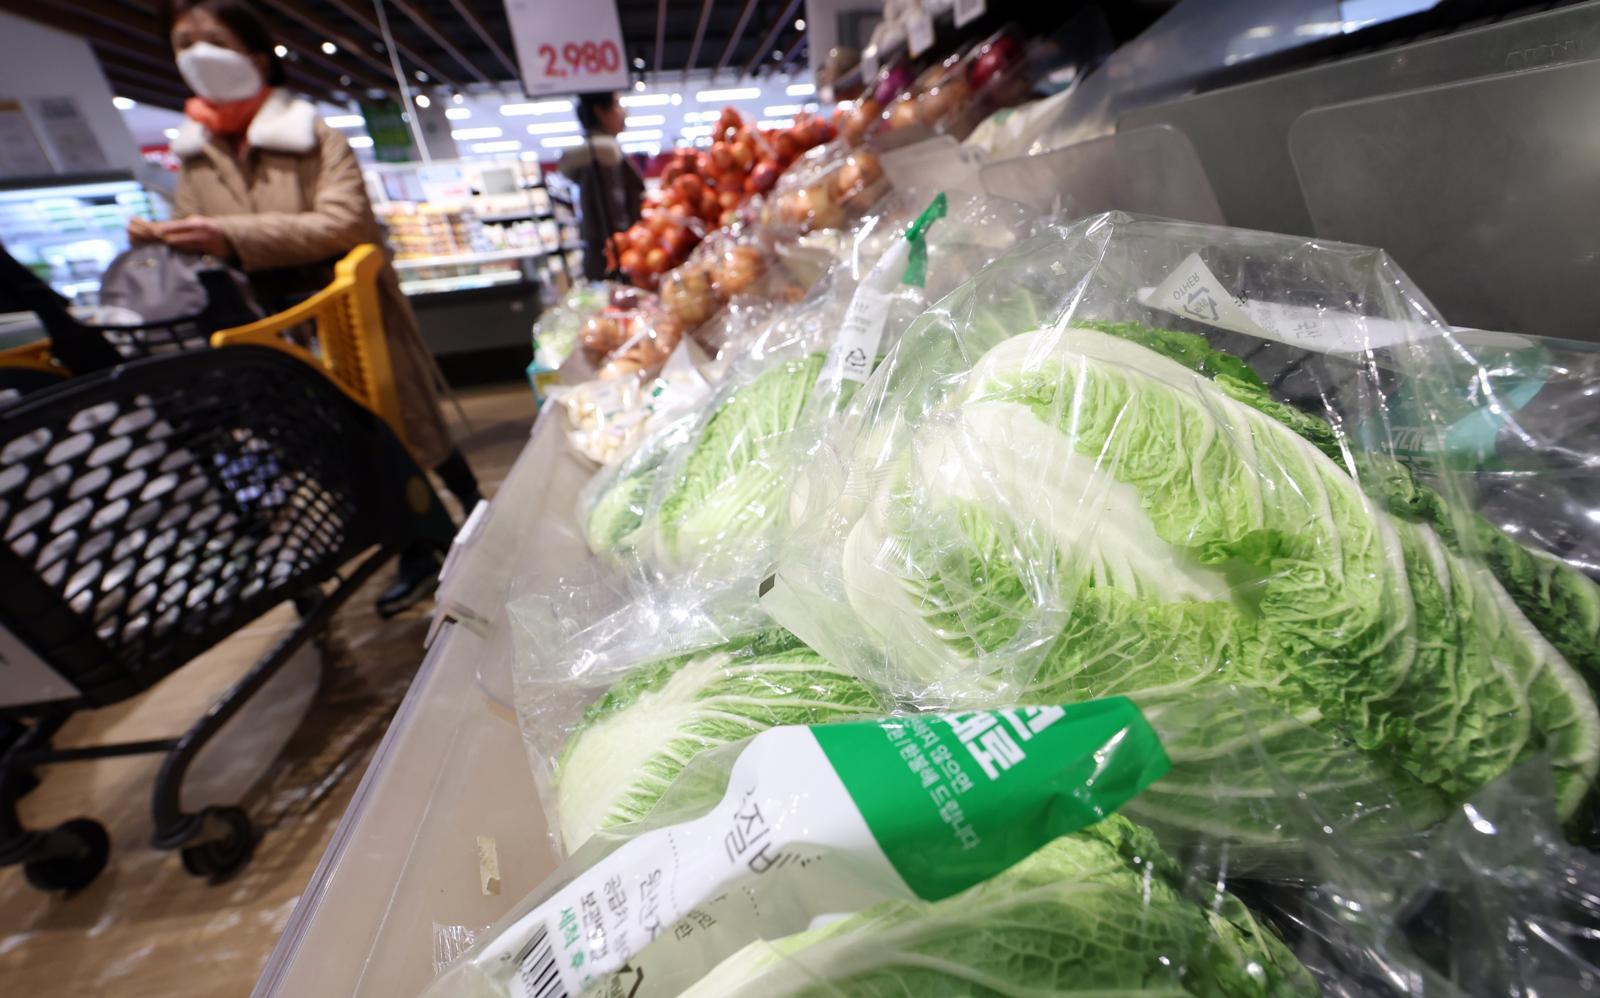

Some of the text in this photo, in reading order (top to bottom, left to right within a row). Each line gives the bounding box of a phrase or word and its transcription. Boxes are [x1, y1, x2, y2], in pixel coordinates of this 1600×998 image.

[929, 744, 974, 795] 않으면
[937, 711, 1026, 780] 대로
[930, 784, 981, 851] 드립니다
